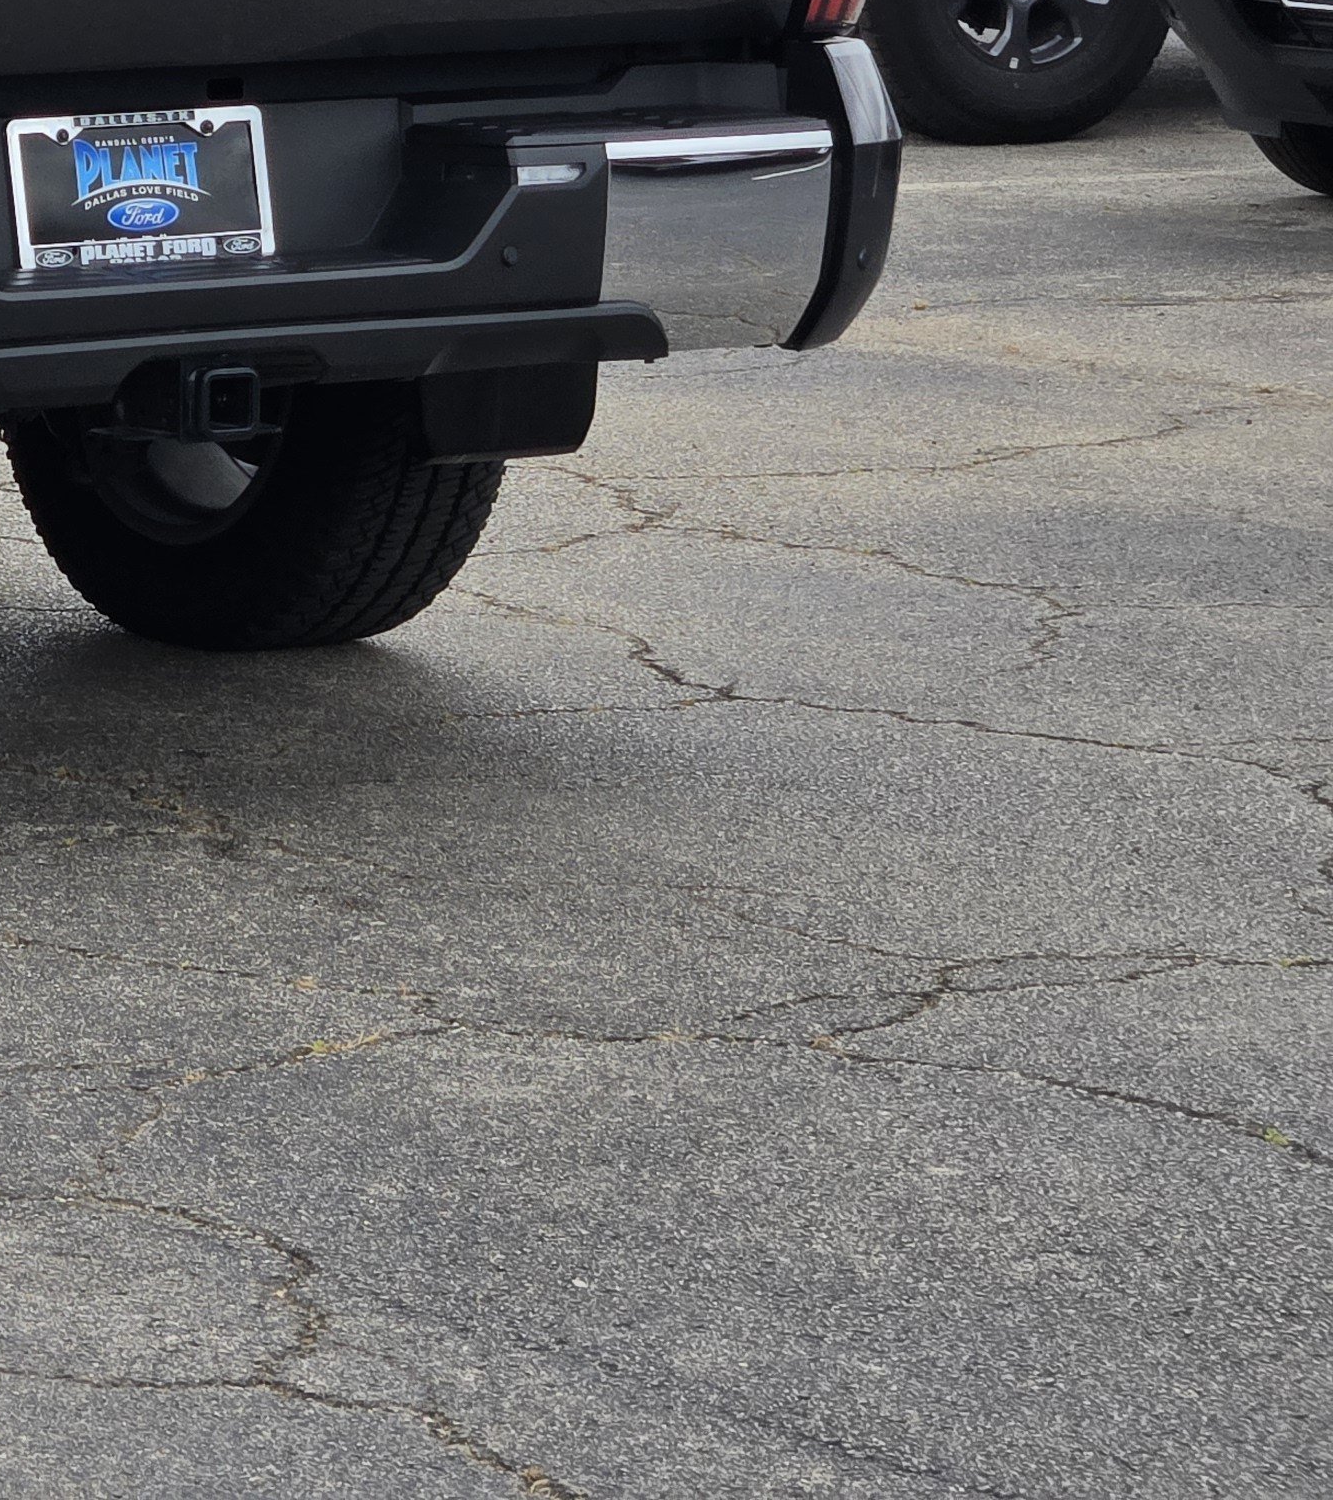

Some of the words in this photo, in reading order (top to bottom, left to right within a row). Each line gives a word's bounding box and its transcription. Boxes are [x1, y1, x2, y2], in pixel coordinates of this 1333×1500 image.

[72, 138, 199, 200] PLANET
[84, 189, 128, 210] DALLAS
[132, 185, 162, 195] LOVE
[166, 187, 199, 202] FIELD
[121, 203, 165, 226] Ford
[80, 241, 157, 266] PLANET
[162, 237, 217, 256] FORD
[231, 239, 255, 251] Ford
[42, 252, 67, 265] Ford
